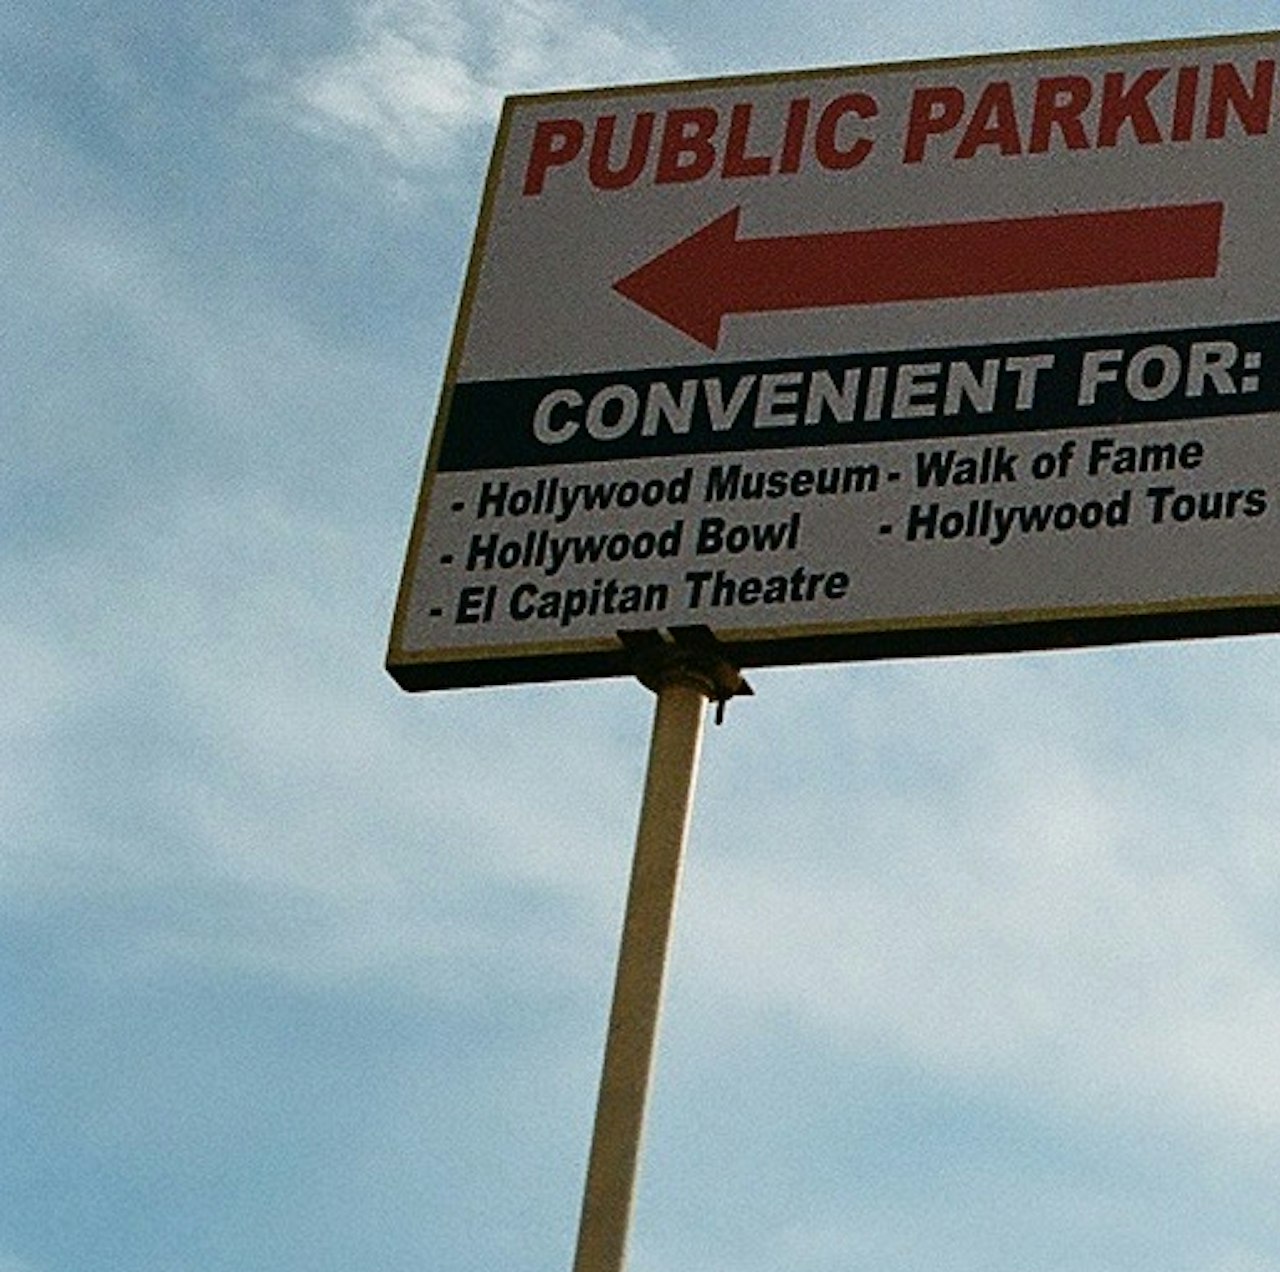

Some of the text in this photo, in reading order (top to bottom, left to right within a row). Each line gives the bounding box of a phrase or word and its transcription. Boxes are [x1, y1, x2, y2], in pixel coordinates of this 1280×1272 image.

[522, 93, 879, 197] PUBLIC
[532, 341, 1260, 446] CONVENIENT FOR:
[477, 457, 880, 525] Hollywood Museum
[914, 436, 1205, 489] Walk of Fame
[466, 513, 800, 576] Hollywood Bowl
[905, 484, 1268, 550] Hollywood Tours
[456, 565, 850, 631] El Capitan Theatre
